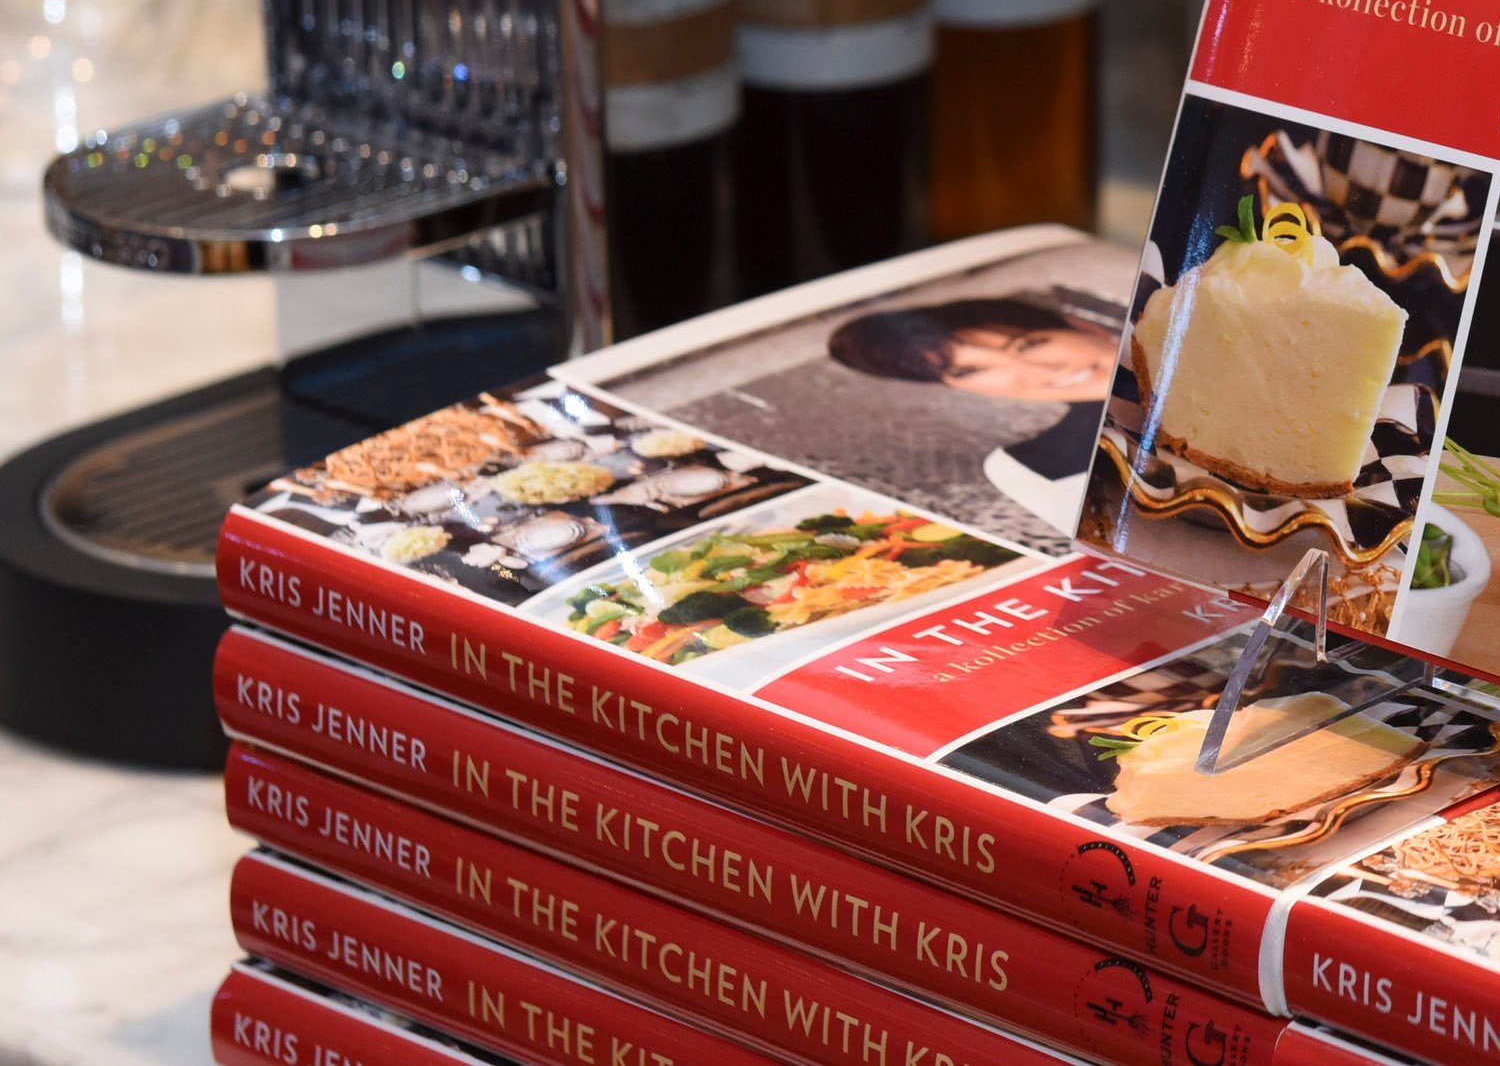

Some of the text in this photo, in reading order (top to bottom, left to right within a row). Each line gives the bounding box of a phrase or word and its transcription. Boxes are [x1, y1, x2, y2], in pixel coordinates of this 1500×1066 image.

[834, 646, 921, 683] IN
[912, 598, 1049, 647] THE
[933, 669, 954, 684] a
[951, 614, 1104, 676] kollection
[1104, 599, 1137, 619] of
[239, 559, 302, 609] KRIS
[311, 587, 427, 655] JENNER
[450, 632, 488, 681] IN
[502, 652, 575, 715] THE
[592, 687, 765, 787] KITCHEN
[782, 755, 887, 833] WITH
[905, 805, 997, 874] KRIS
[236, 673, 1009, 991] KRIS JENNER IN THE KITCHEN WITH KRIS
[246, 776, 888, 1066] KRIS JENNER IN THE KITCHEN WITH
[1145, 875, 1163, 955] HUNTER
[1169, 903, 1209, 957] G
[252, 900, 316, 953] KRIS
[327, 930, 444, 1001] JENNER
[468, 982, 505, 1029] IN
[520, 1001, 595, 1064] THE
[1312, 952, 1392, 1014] KRIS
[234, 1011, 298, 1066] KRIS
